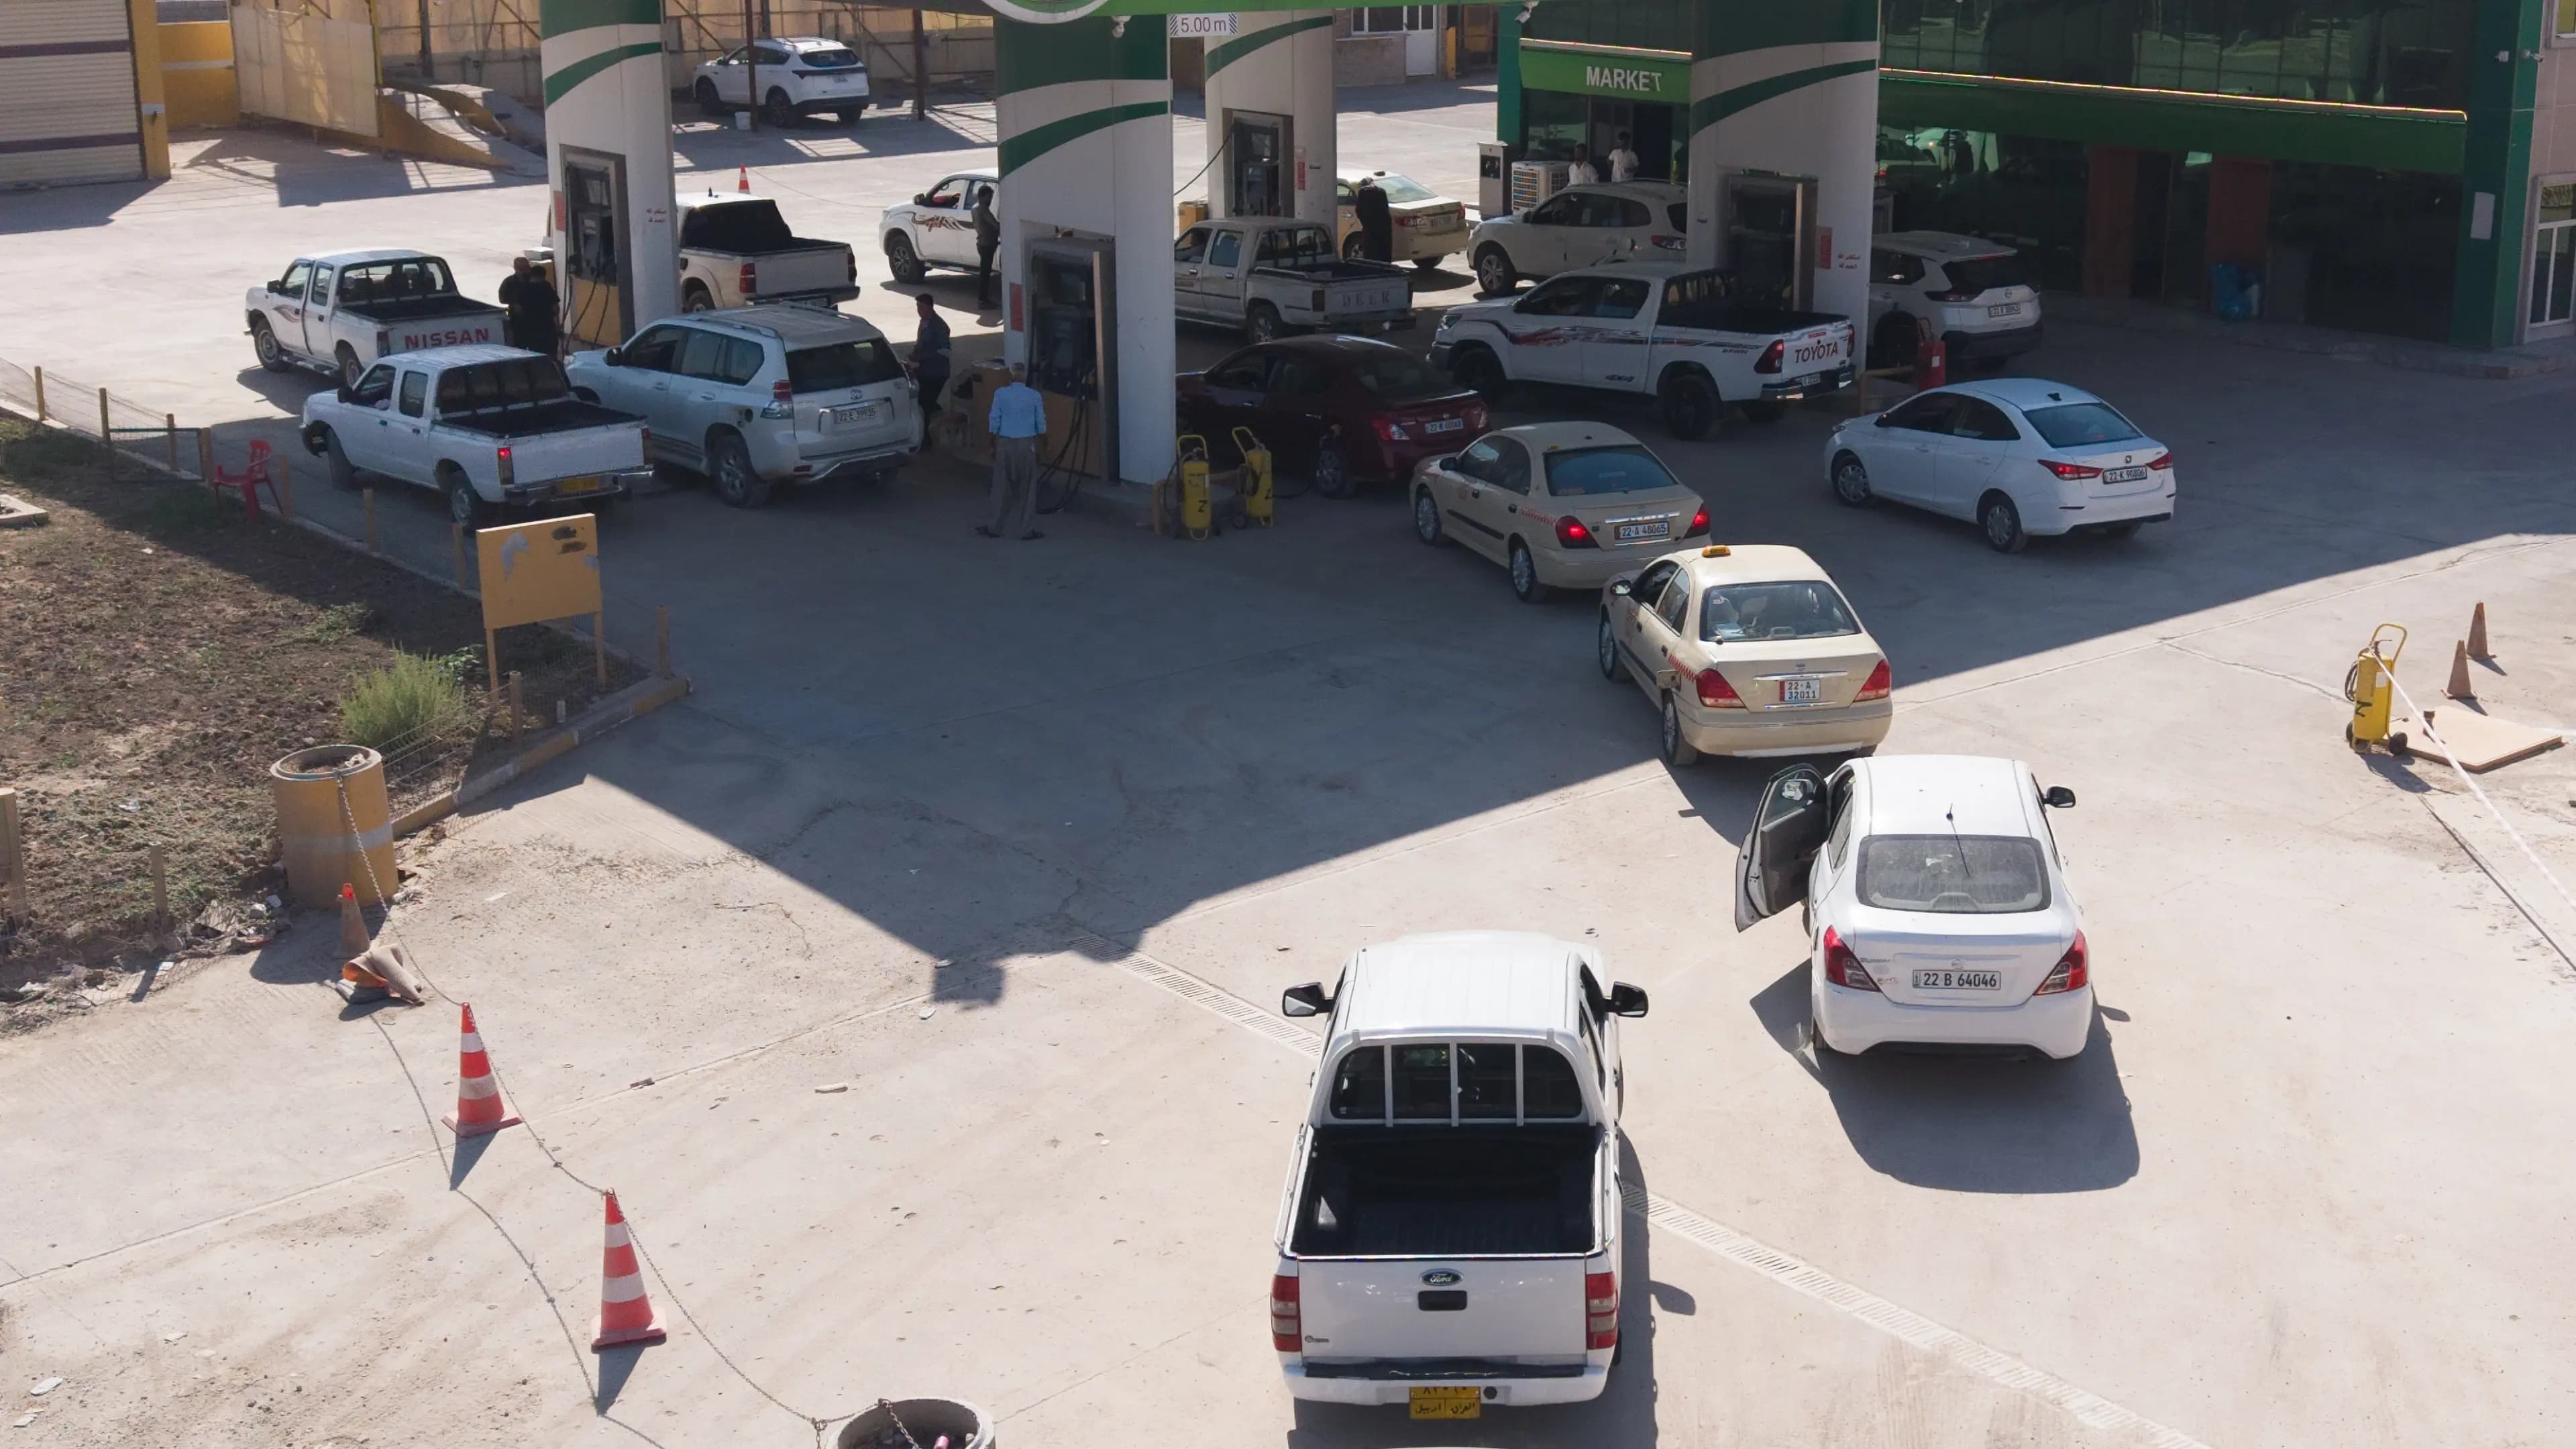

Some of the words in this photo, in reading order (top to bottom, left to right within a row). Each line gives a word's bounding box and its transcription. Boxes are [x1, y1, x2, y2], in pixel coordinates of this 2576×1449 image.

[1181, 17, 1211, 33] 5.00
[1214, 19, 1226, 32] m
[1586, 66, 1662, 92] MARKET
[405, 327, 489, 350] NISSAN
[1794, 341, 1838, 364] TOYOTA
[1642, 523, 1667, 535] 48065
[1788, 690, 1816, 700] 32011
[1923, 973, 1939, 986] 22
[1944, 973, 1953, 987] B
[1957, 973, 1997, 987] 64046
